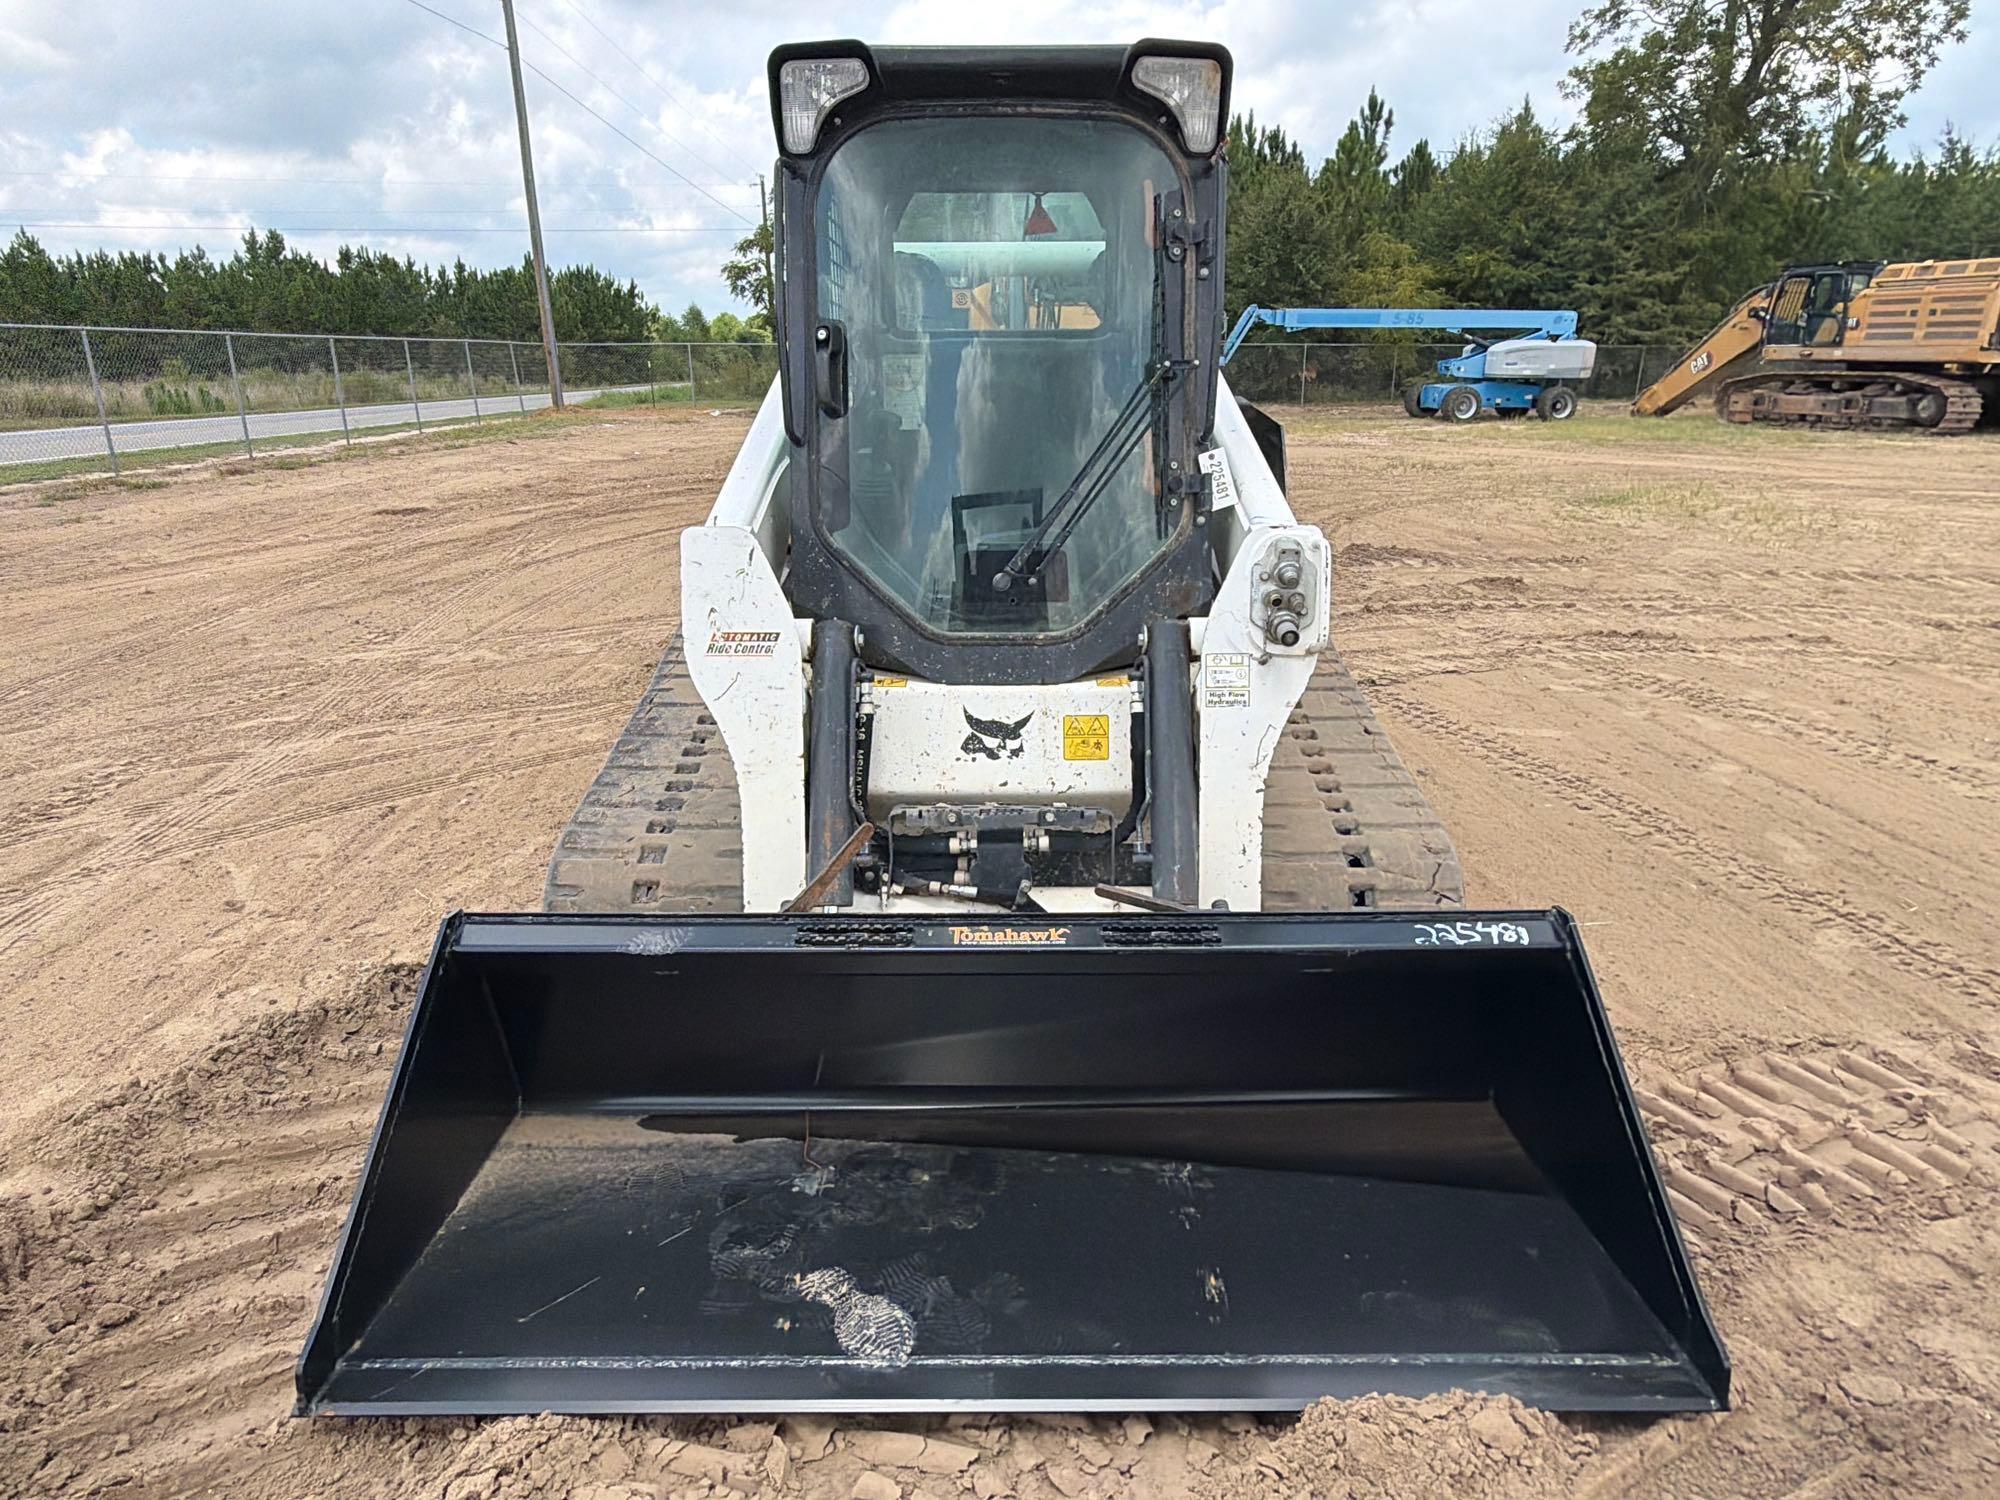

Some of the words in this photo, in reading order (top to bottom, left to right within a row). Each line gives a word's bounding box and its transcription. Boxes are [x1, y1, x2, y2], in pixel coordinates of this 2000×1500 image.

[1690, 352, 1708, 374] CAT
[1210, 461, 1230, 499] 225481
[706, 642, 732, 654] Ride
[948, 926, 1072, 945] Tomahawk
[1413, 921, 1530, 946] 225481
